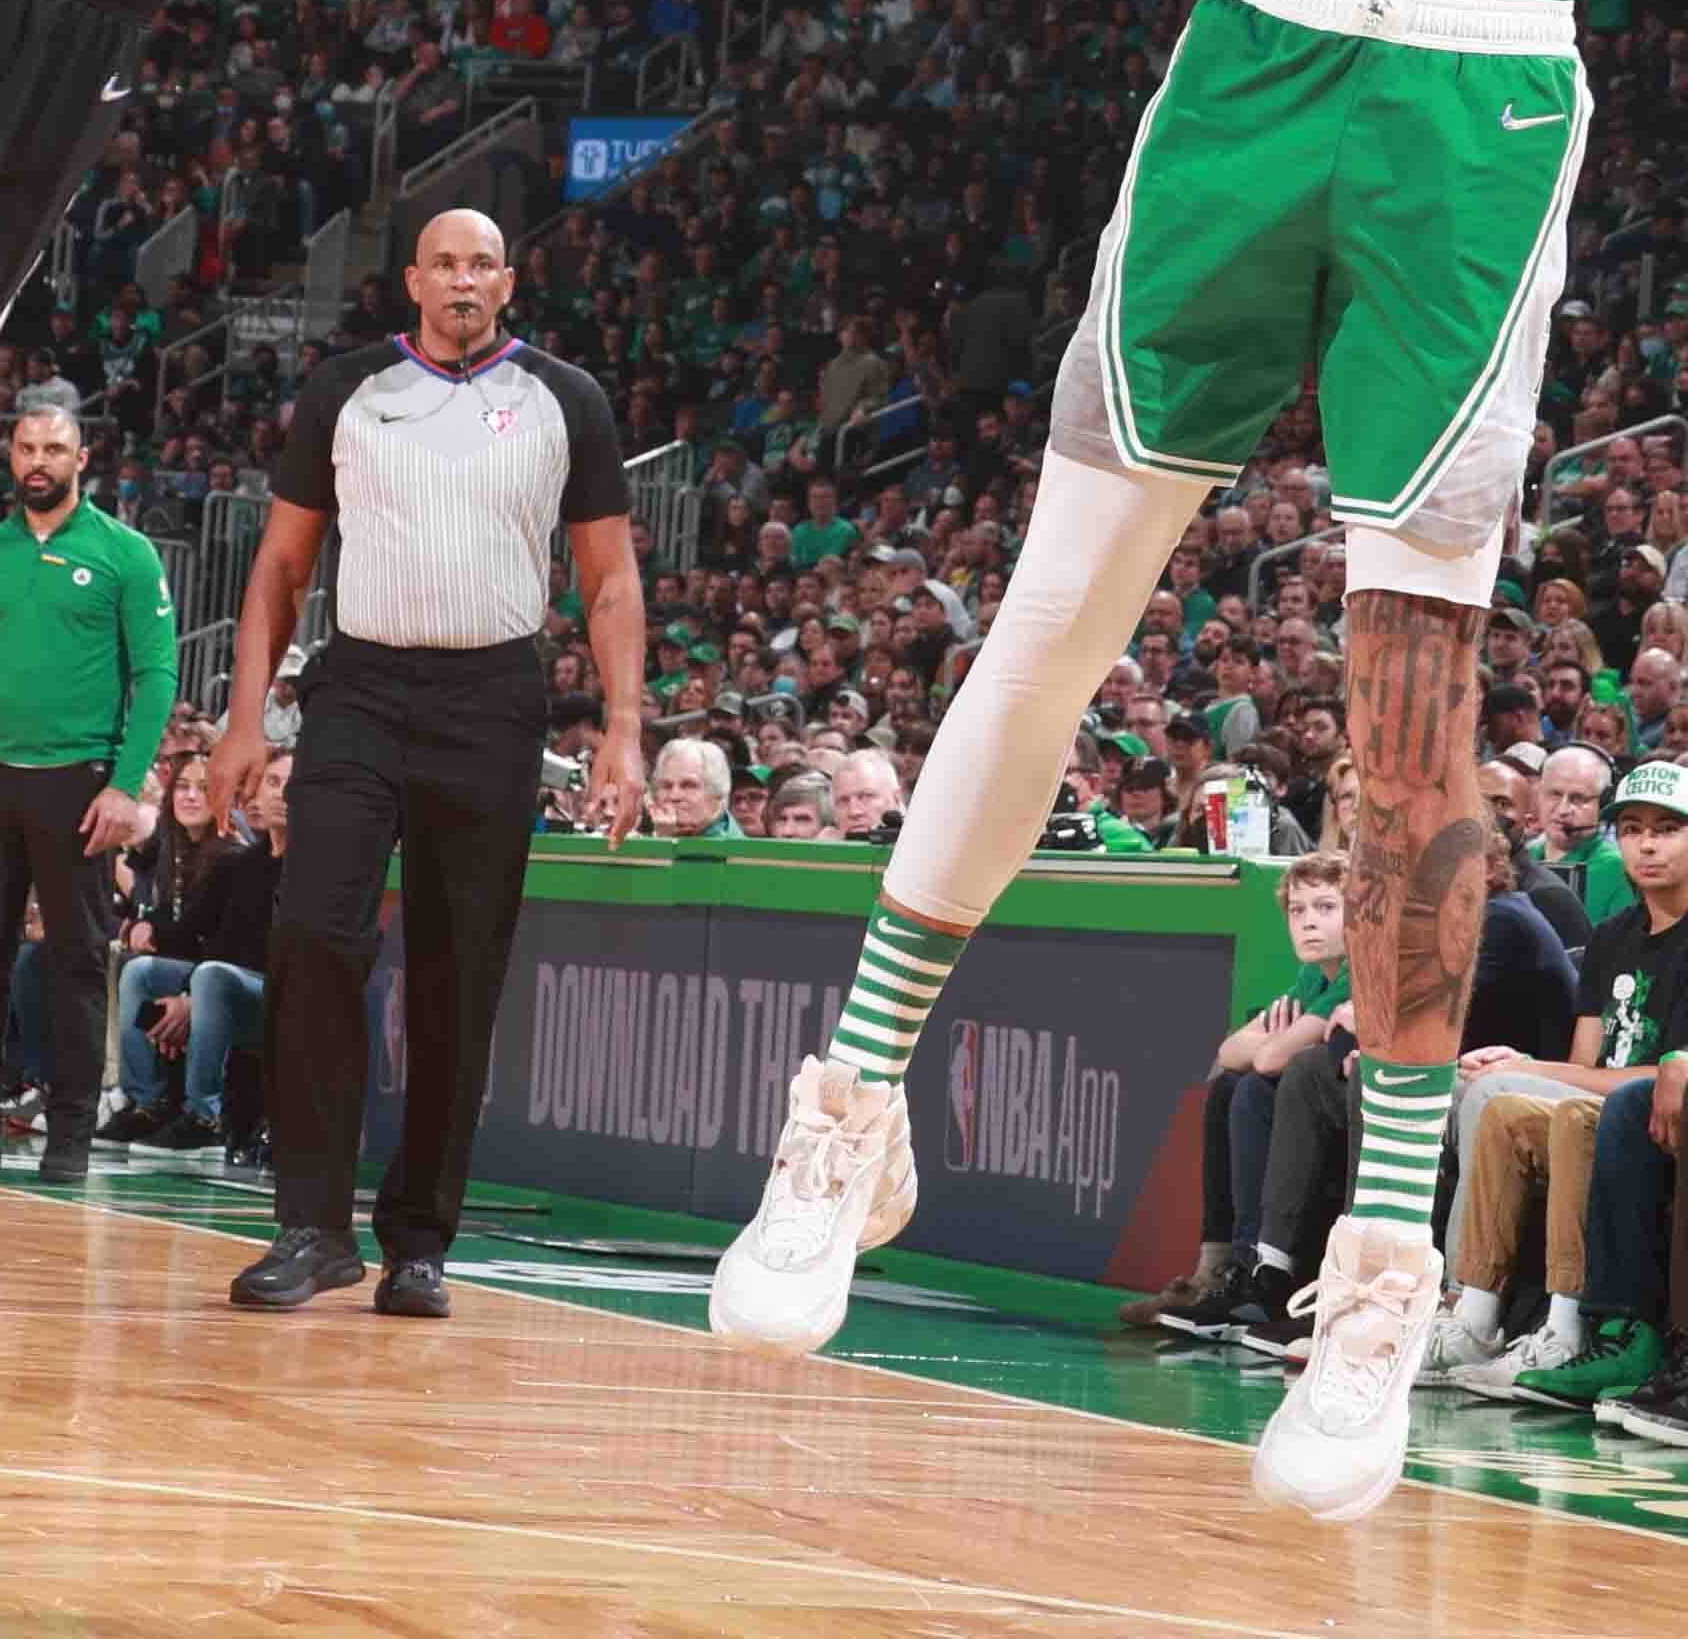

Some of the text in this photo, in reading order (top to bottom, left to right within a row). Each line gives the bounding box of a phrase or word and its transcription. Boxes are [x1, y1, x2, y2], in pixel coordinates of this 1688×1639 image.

[528, 962, 729, 1149] DOWNLOAD
[976, 1025, 1120, 1219] NBA App
